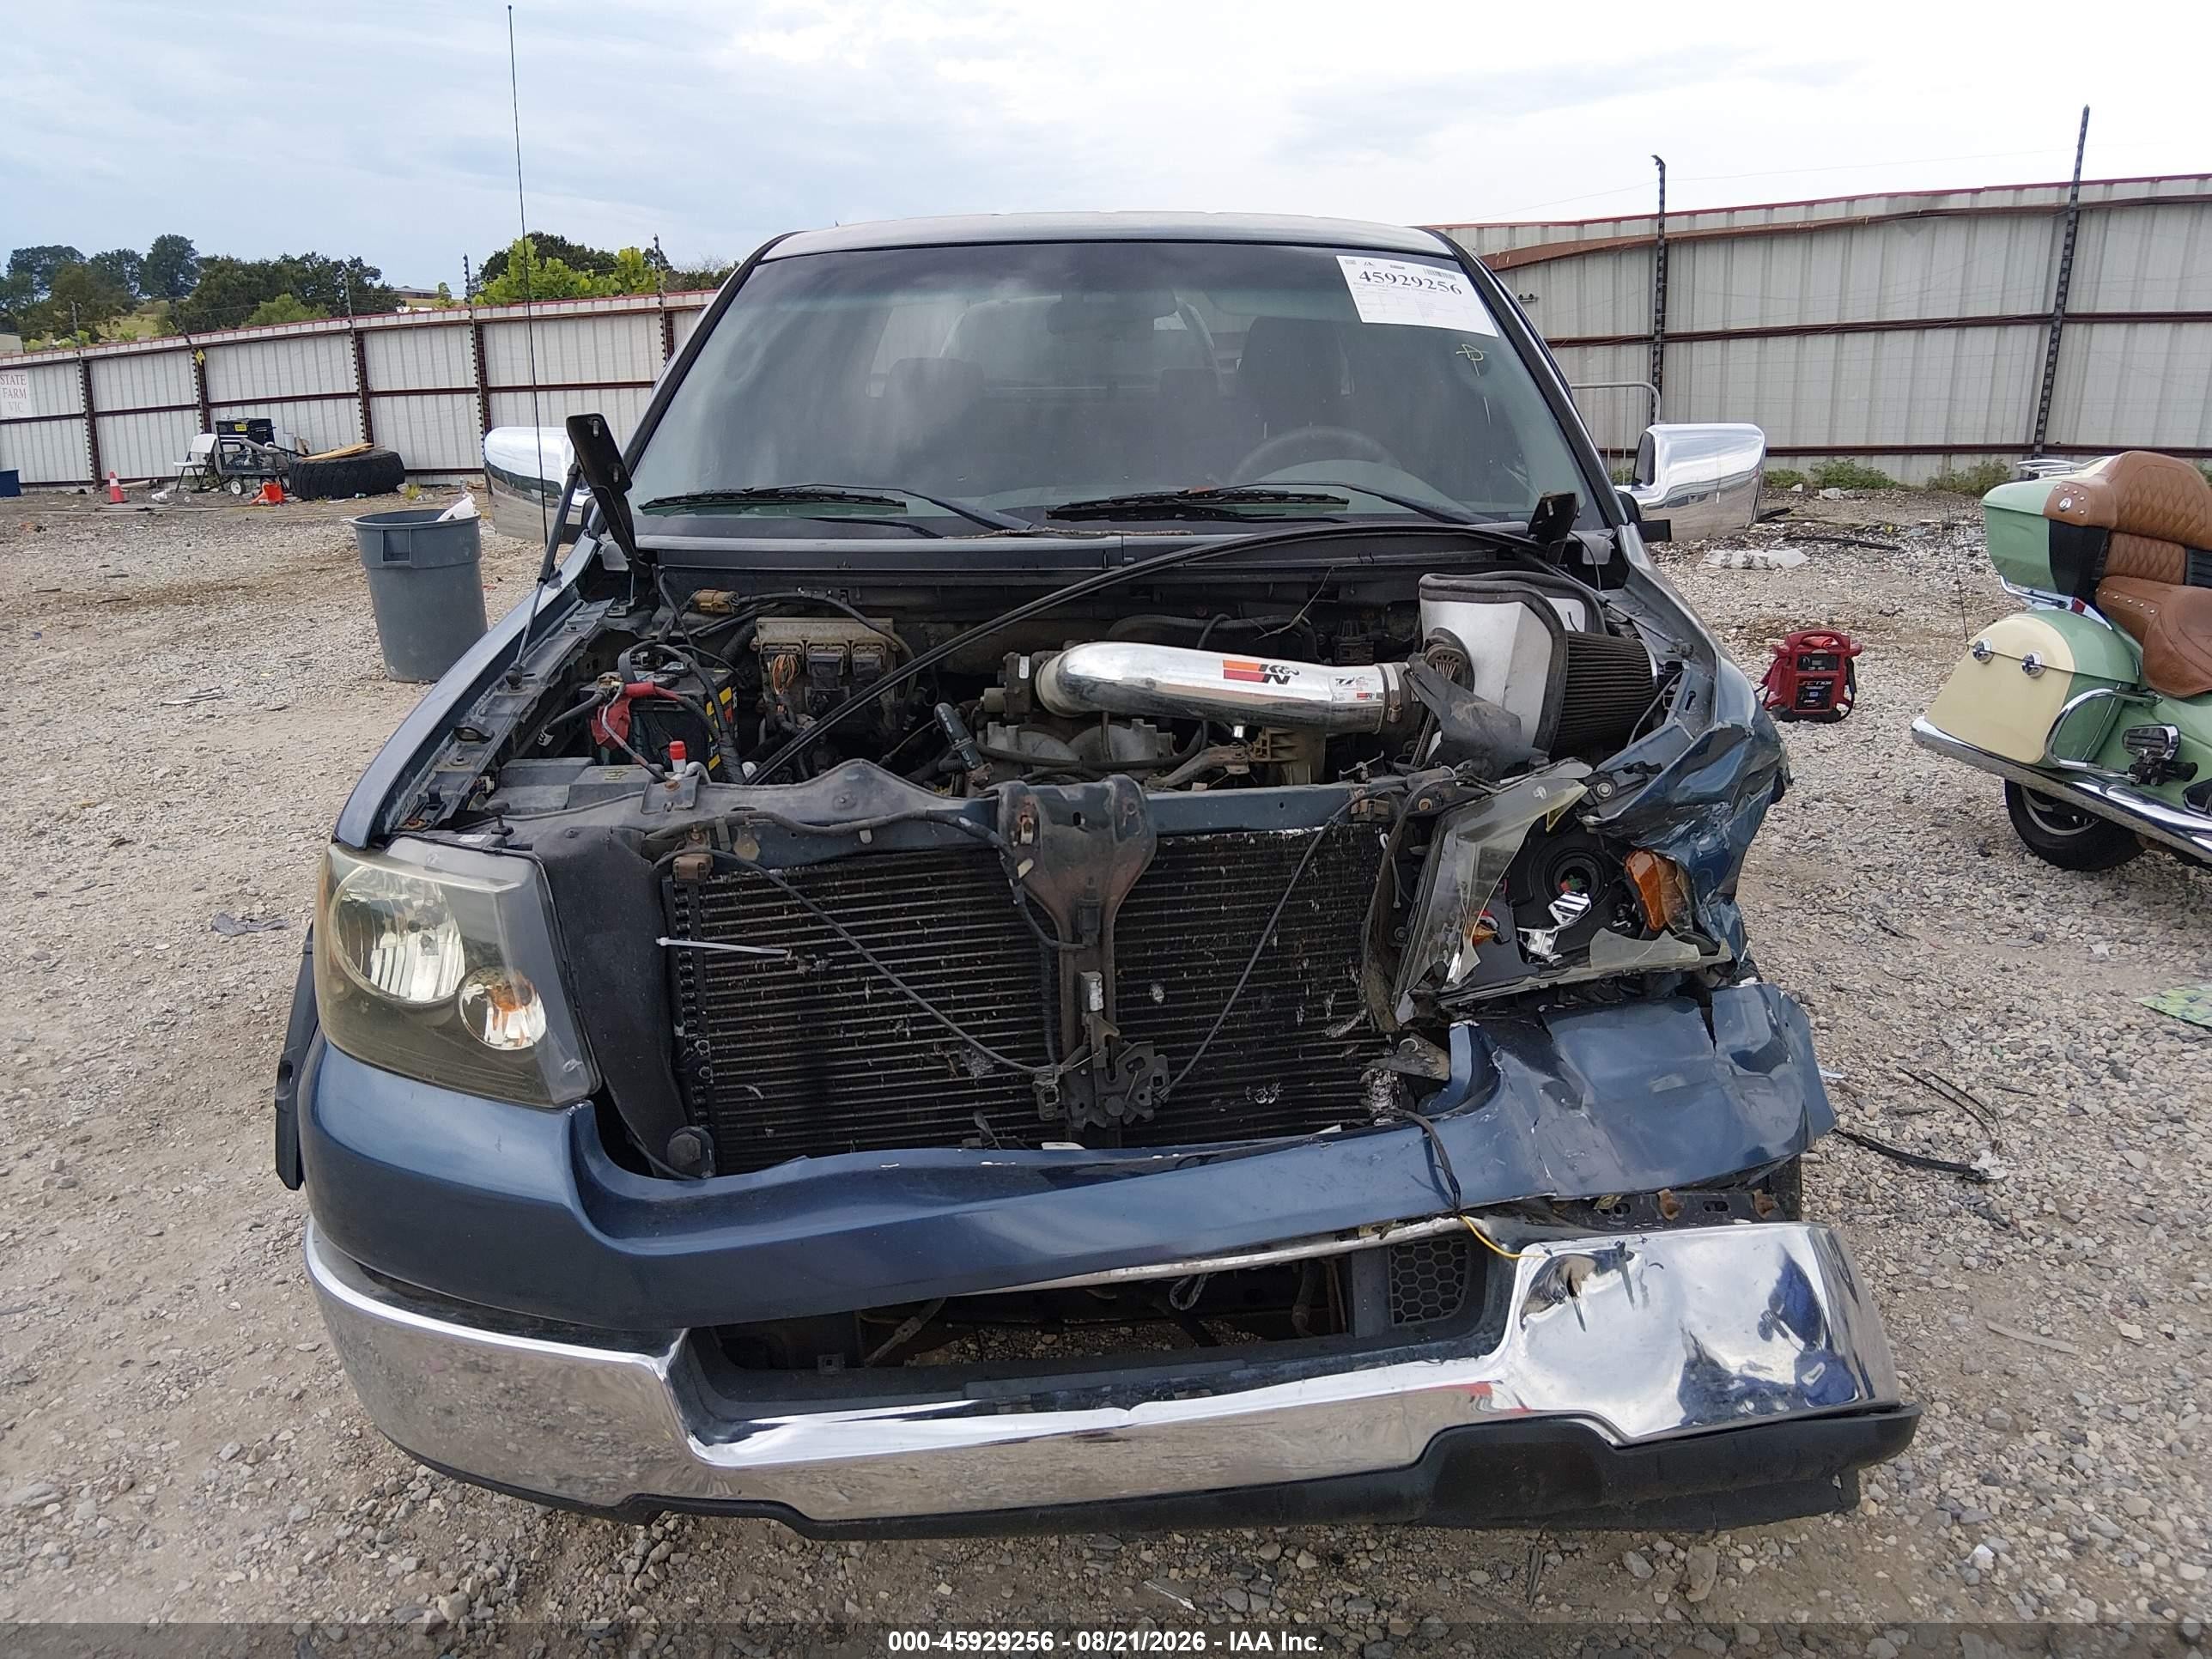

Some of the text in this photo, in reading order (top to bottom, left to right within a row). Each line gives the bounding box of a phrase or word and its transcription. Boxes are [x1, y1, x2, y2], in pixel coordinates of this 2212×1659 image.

[1358, 270, 1462, 295] 45929256
[0, 374, 27, 386] STATE
[2, 387, 27, 399] FARM
